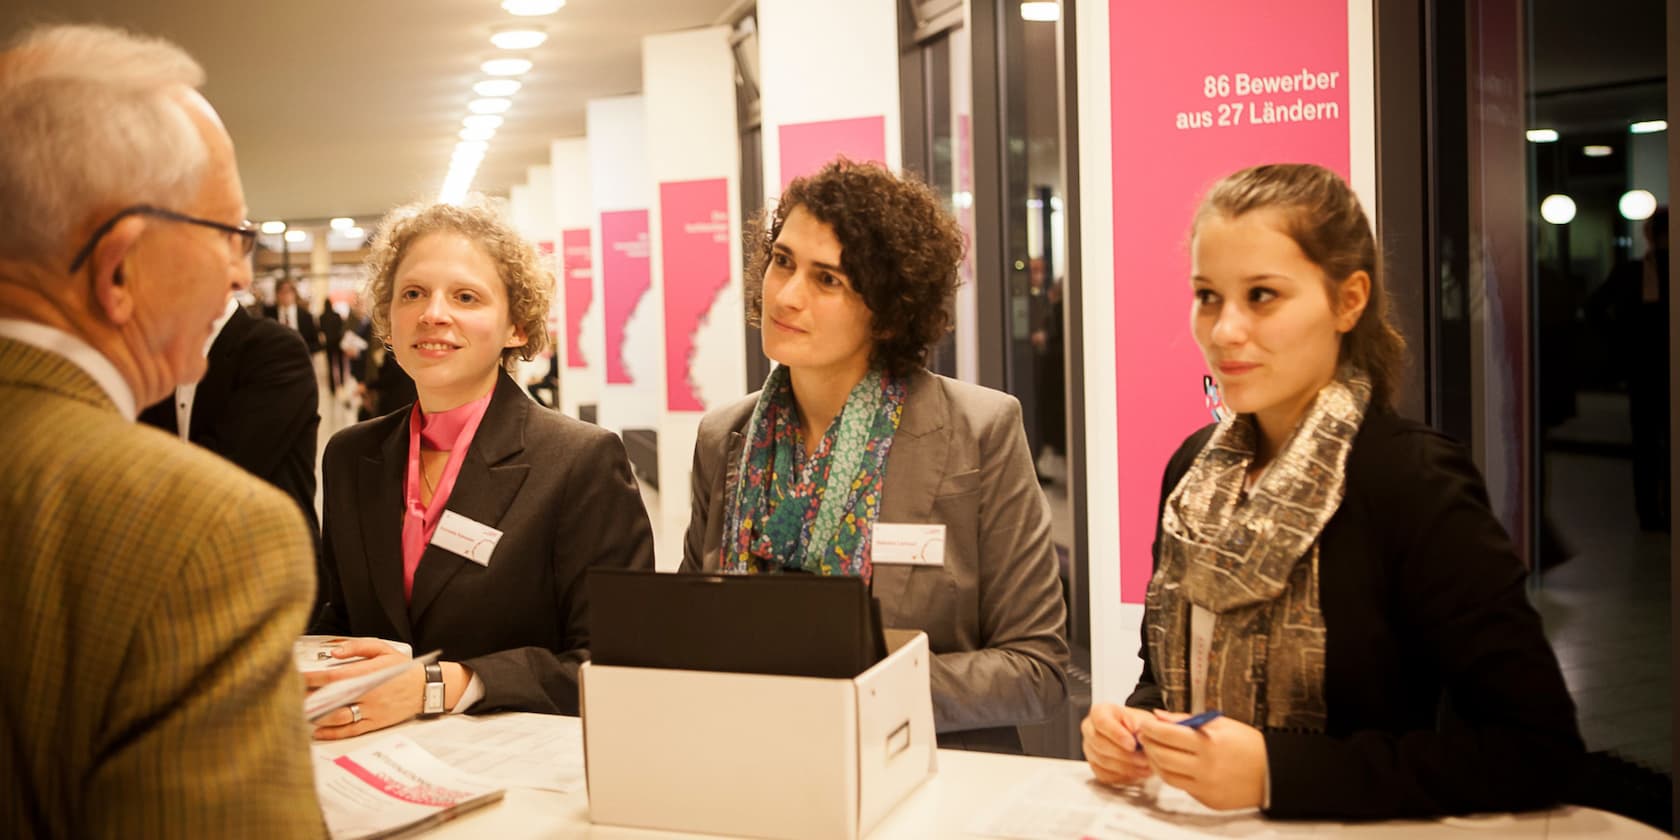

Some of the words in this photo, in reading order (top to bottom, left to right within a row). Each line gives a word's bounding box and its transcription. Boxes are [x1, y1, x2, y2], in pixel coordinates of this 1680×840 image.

[1204, 74, 1230, 98] 86
[1235, 68, 1339, 96] Bewerber
[1176, 110, 1213, 129] aus
[1217, 103, 1244, 126] 27
[1250, 98, 1339, 124] Ländern
